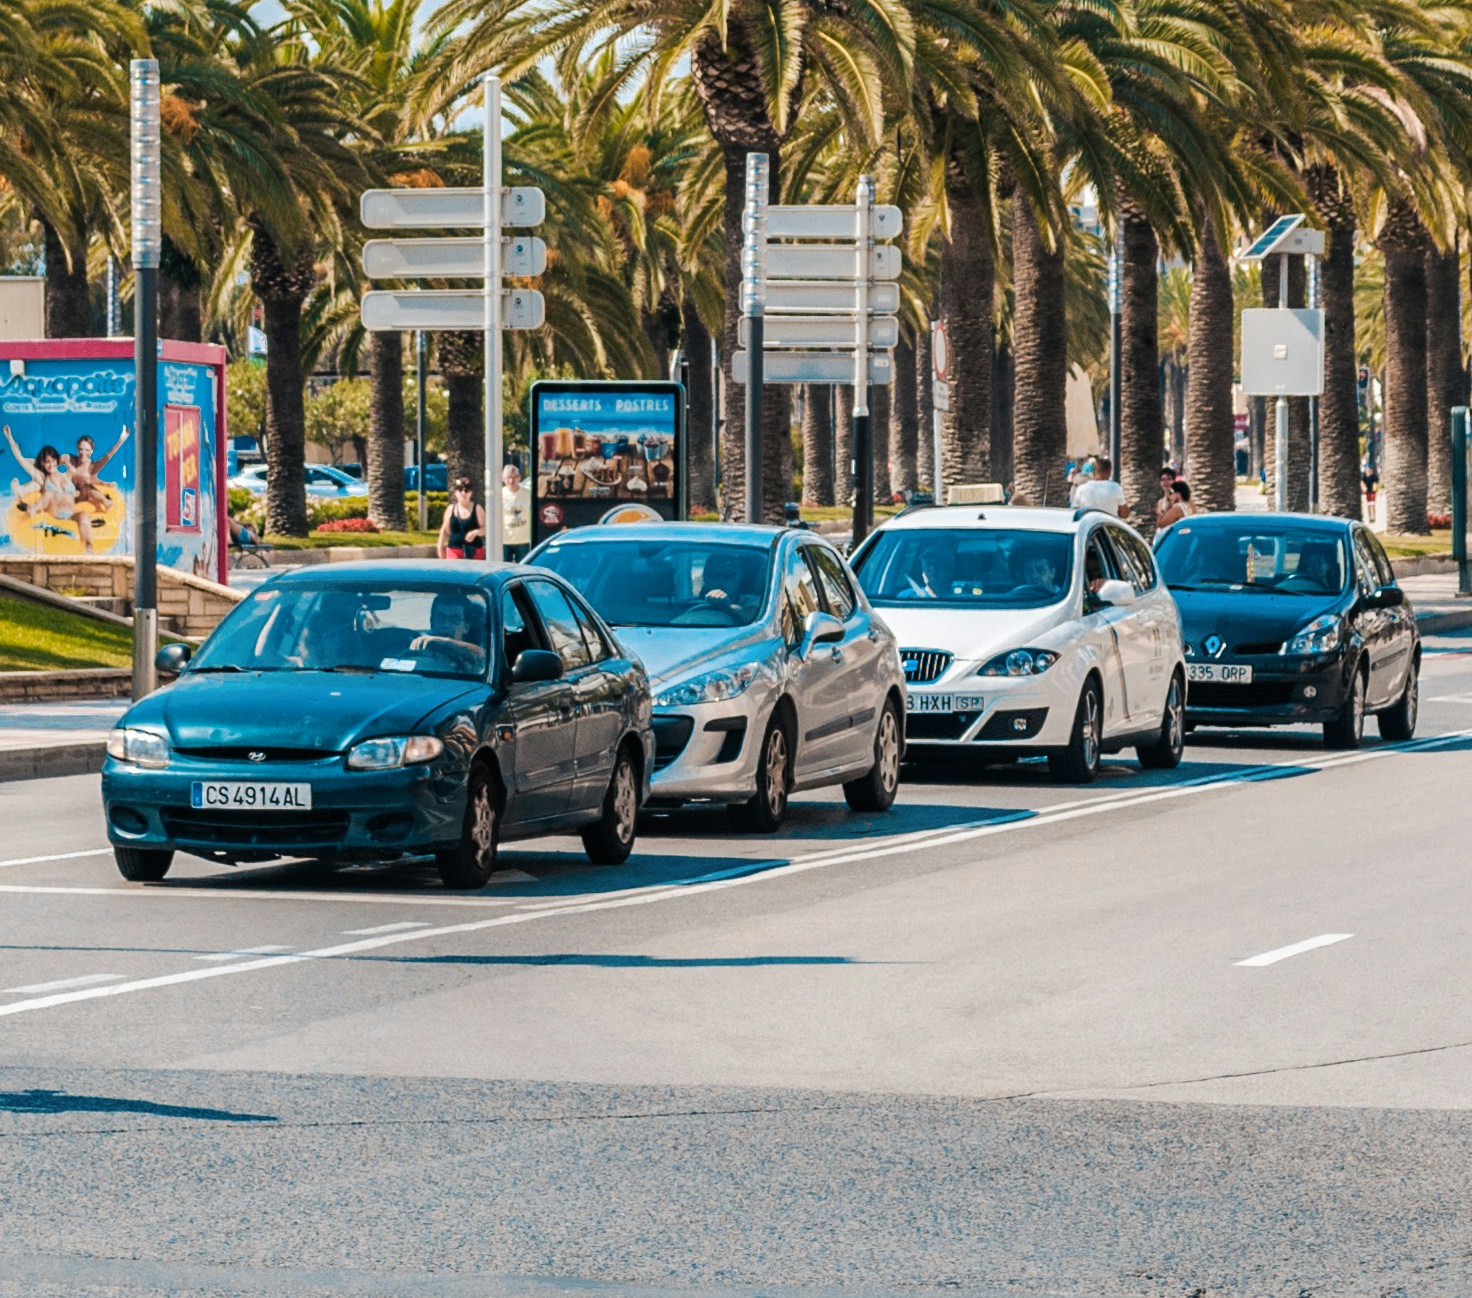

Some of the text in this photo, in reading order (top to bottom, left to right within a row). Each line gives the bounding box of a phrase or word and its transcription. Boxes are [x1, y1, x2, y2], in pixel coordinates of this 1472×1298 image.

[543, 399, 670, 413] DESSERTS POSTRES
[1187, 665, 1214, 680] 335
[919, 695, 952, 711] HXH
[959, 697, 981, 709] SP
